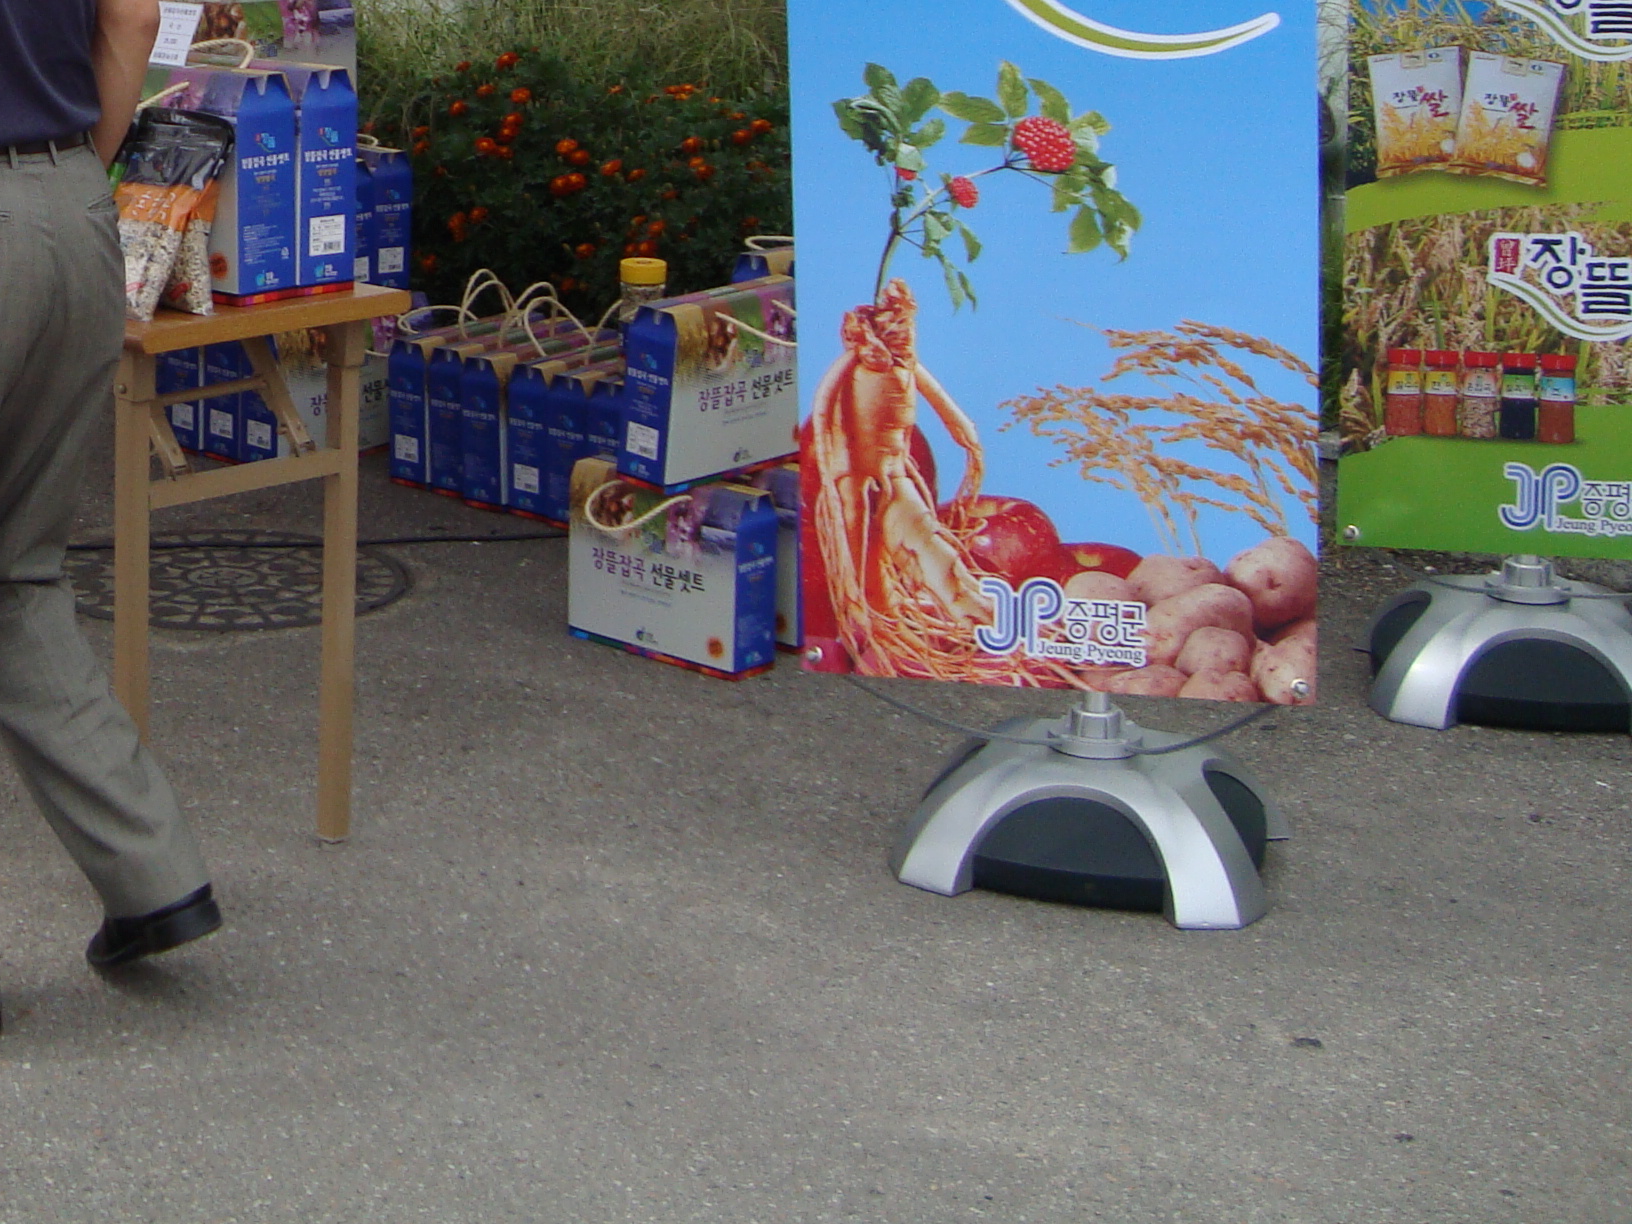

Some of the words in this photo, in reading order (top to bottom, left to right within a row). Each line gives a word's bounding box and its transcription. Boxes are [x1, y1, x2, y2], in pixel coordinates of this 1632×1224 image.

[1530, 236, 1632, 314] 장뜰
[1582, 482, 1631, 517] 증평
[592, 547, 646, 582] 장뜰잡곡
[651, 562, 706, 594] 선물셋트
[1067, 600, 1145, 643] 증평군
[1038, 641, 1082, 659] Jeung
[1087, 643, 1143, 664] Pyeong
